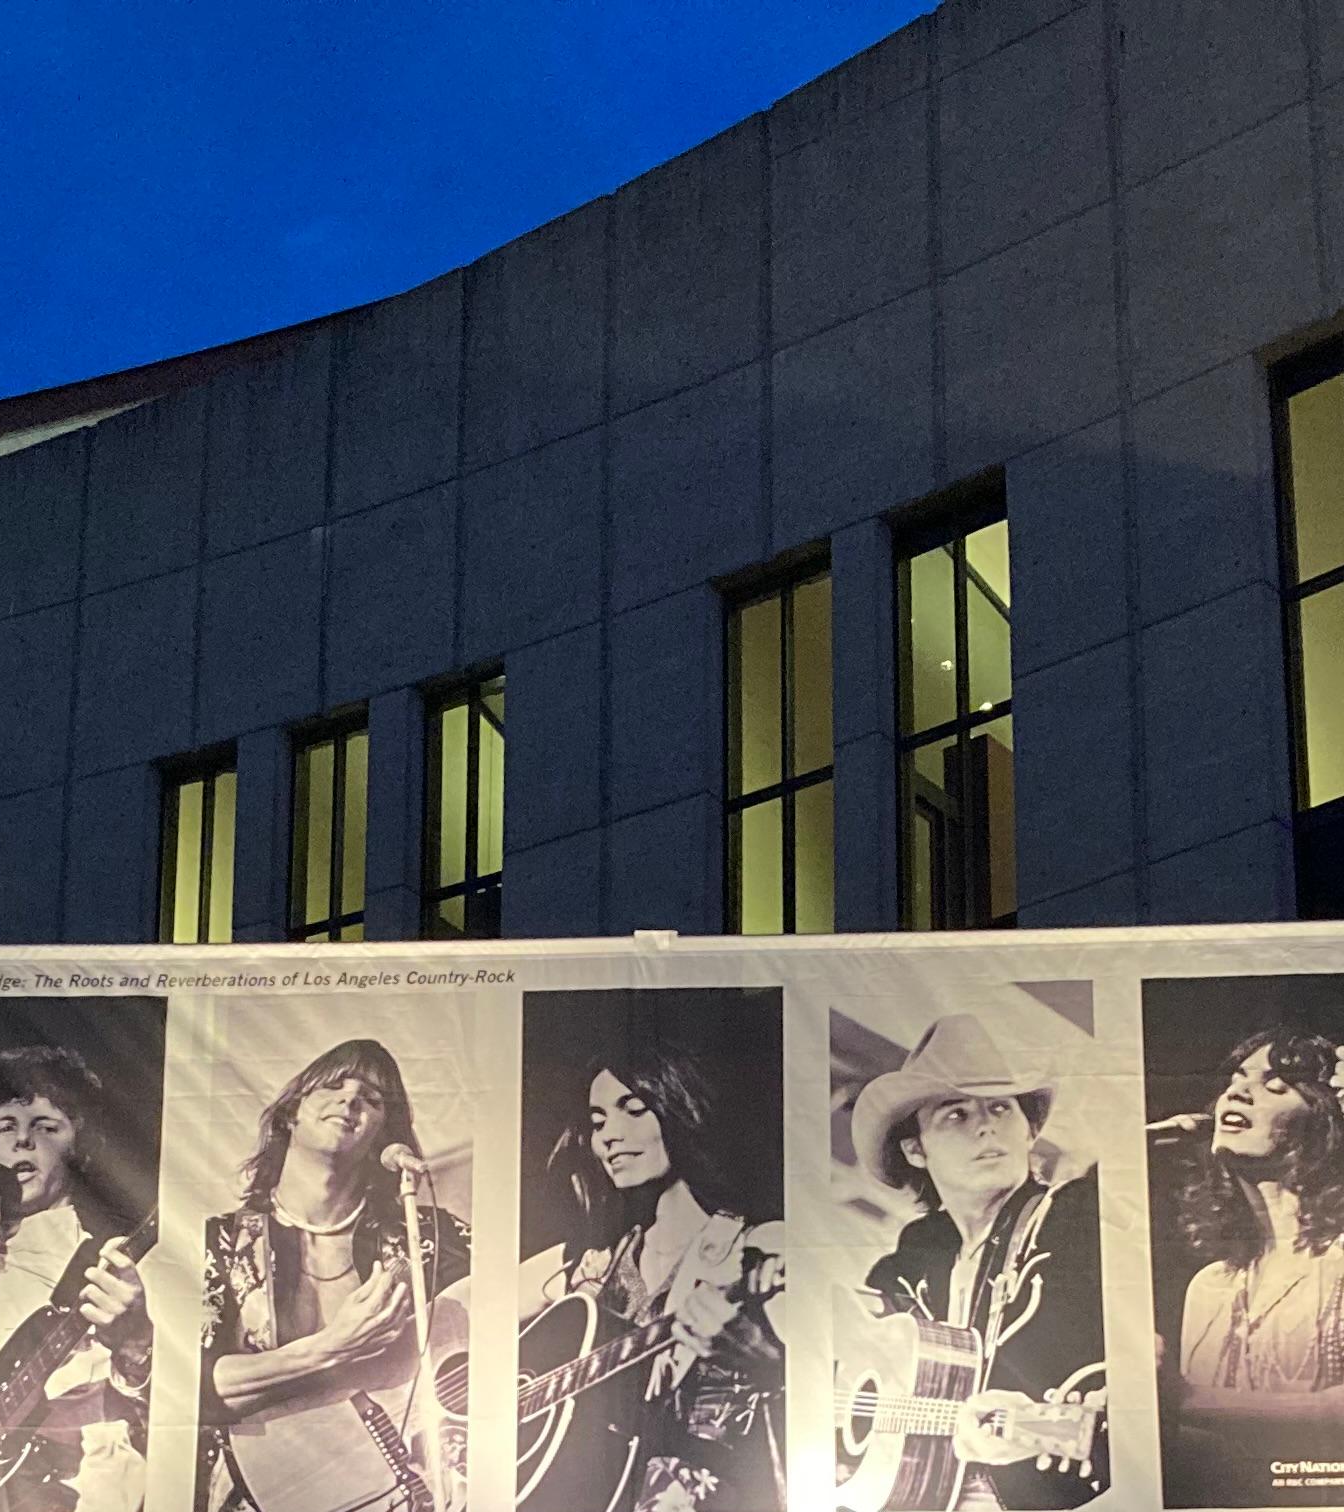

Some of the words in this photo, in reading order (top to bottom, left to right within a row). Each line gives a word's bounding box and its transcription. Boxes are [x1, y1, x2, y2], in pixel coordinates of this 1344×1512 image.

[34, 974, 63, 988] The
[68, 973, 113, 988] Roots
[119, 973, 150, 988] and
[156, 972, 275, 988] Reverberations
[281, 971, 299, 986] of
[303, 972, 331, 986] Los
[336, 971, 400, 988] Angeles
[406, 969, 516, 987] Country-Rock
